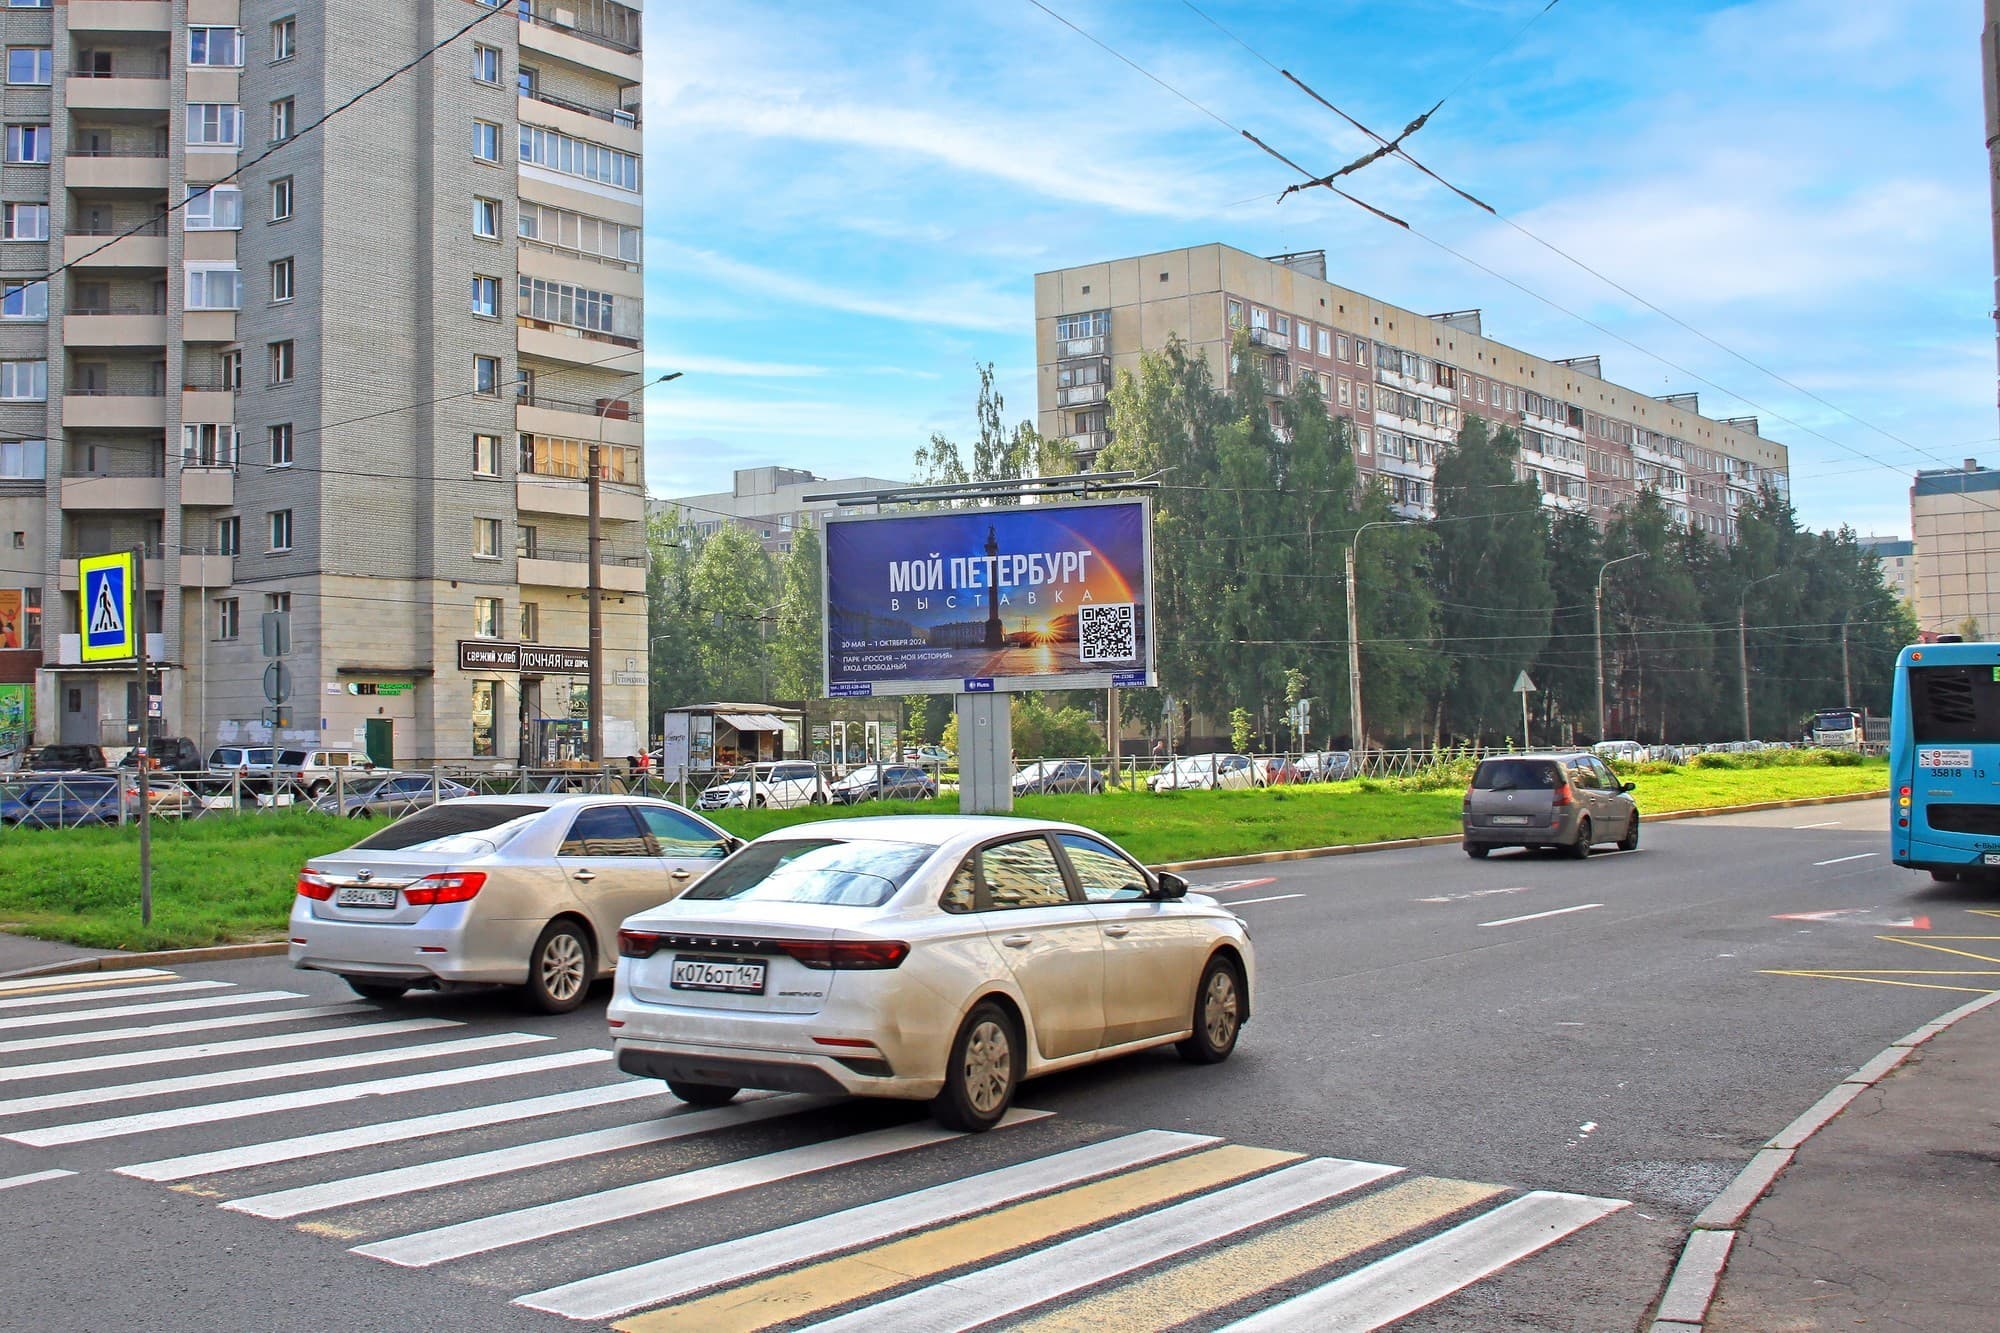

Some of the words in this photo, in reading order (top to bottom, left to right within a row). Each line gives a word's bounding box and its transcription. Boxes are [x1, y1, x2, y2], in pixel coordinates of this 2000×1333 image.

[889, 553, 943, 593] МОЙ
[950, 551, 1092, 590] ПЕТЕРБУРГ
[892, 590, 1093, 611] ВЫСТАВКА
[467, 650, 496, 662] свежий
[497, 651, 517, 663] хлеб
[843, 664, 861, 672] ВХОД
[863, 662, 907, 671] СВОБОДНЫЙ
[1931, 768, 1962, 777] 35818
[1972, 769, 1985, 778] 13
[737, 967, 760, 982] 147
